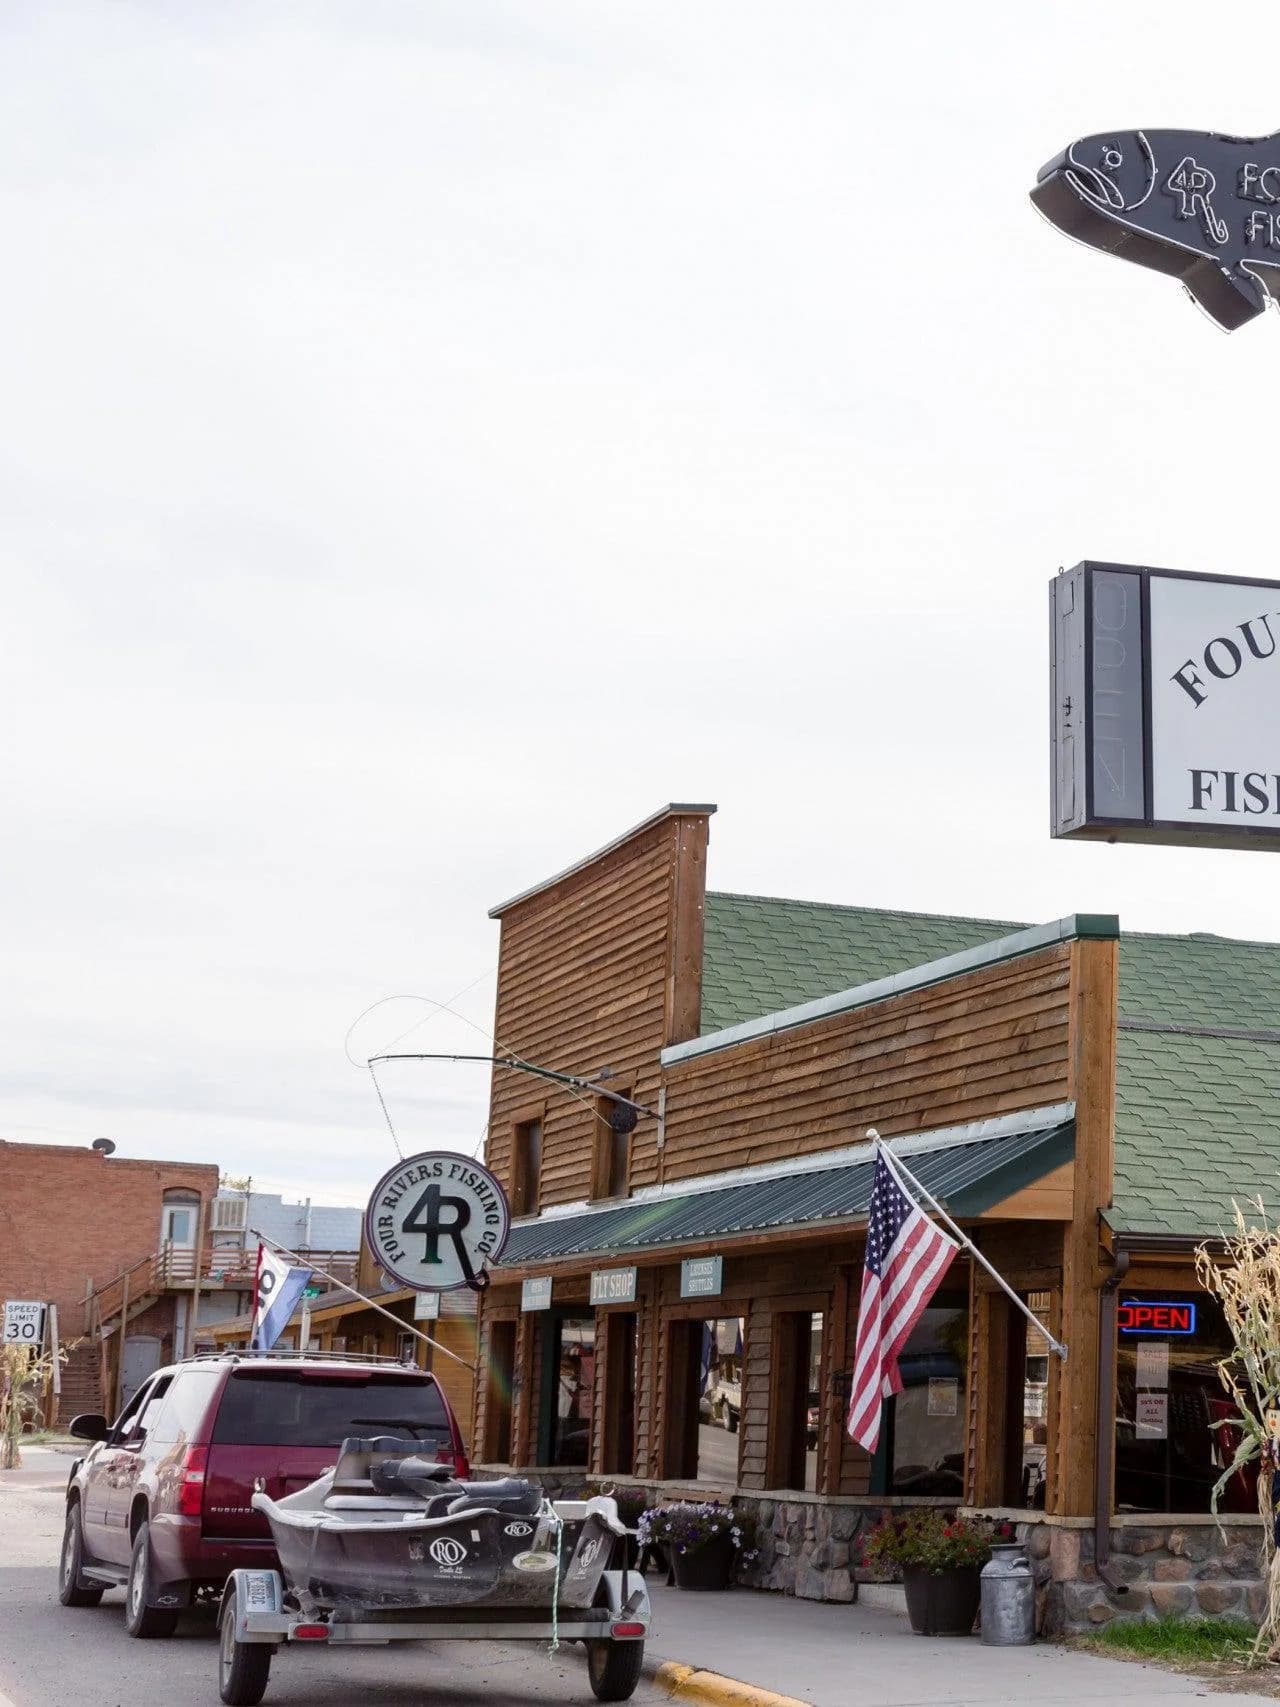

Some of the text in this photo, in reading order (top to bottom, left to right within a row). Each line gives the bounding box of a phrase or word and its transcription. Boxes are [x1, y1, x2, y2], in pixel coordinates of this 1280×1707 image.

[378, 1162, 500, 1264] FOUR RIVERS FISHING CO.
[592, 1272, 634, 1299] FLY SHOP
[1117, 1306, 1189, 1329] OPEN
[6, 1323, 35, 1338] 30
